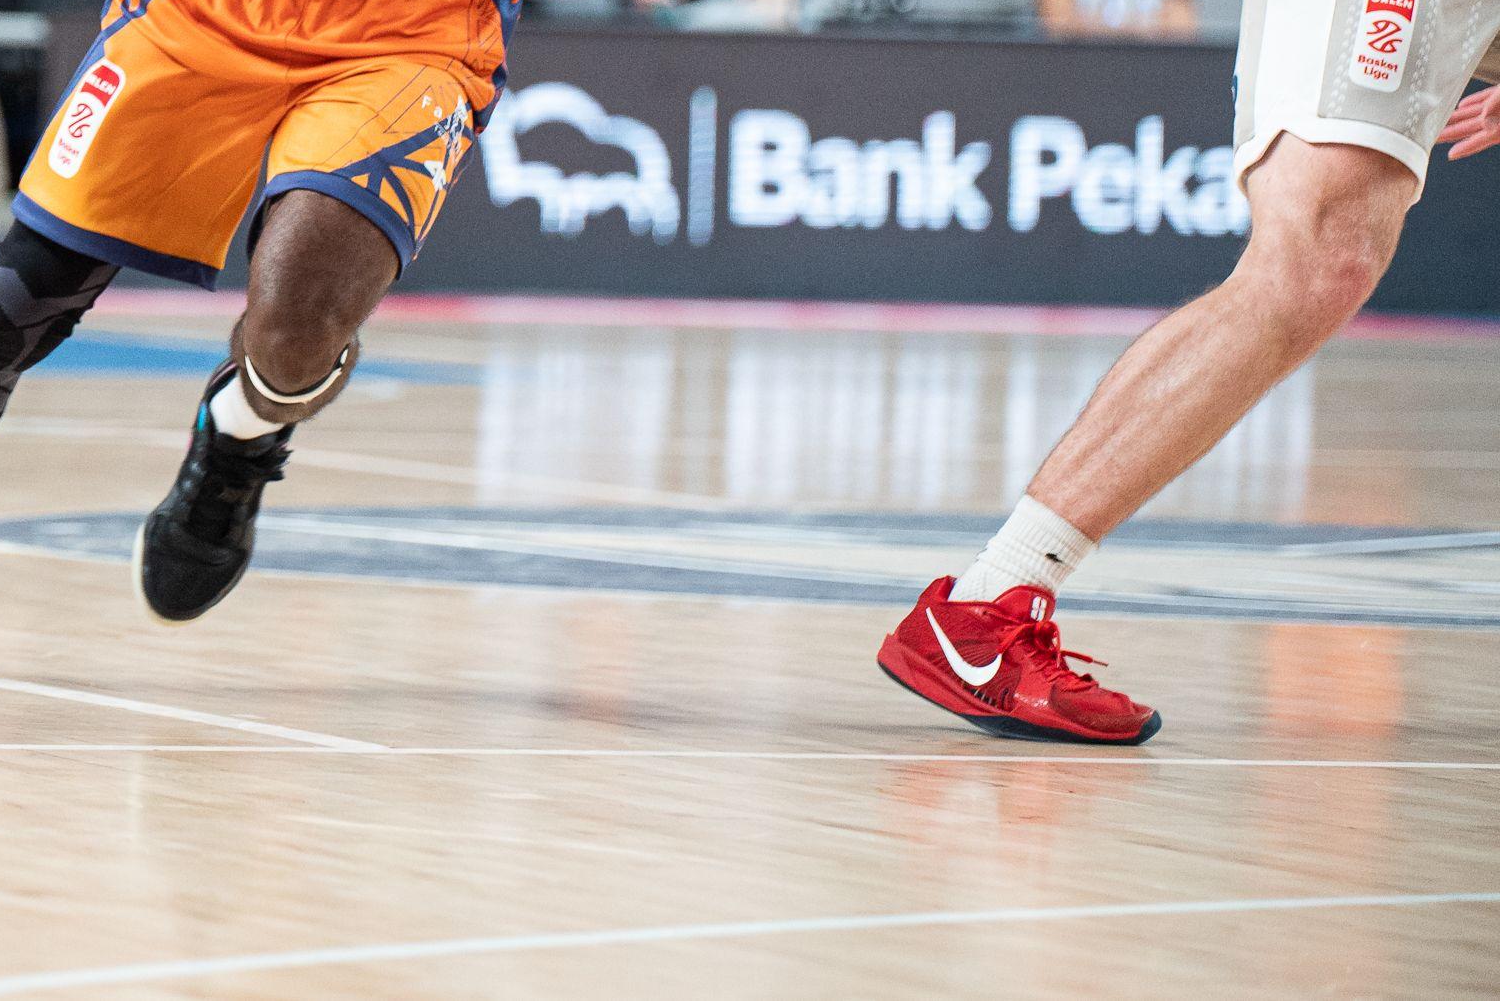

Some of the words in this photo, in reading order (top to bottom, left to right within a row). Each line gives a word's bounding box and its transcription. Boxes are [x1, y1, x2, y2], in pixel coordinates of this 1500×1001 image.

[1358, 55, 1398, 73] Basket
[1364, 66, 1389, 80] Liga
[729, 110, 992, 231] Bank
[1008, 115, 1252, 235] Peka
